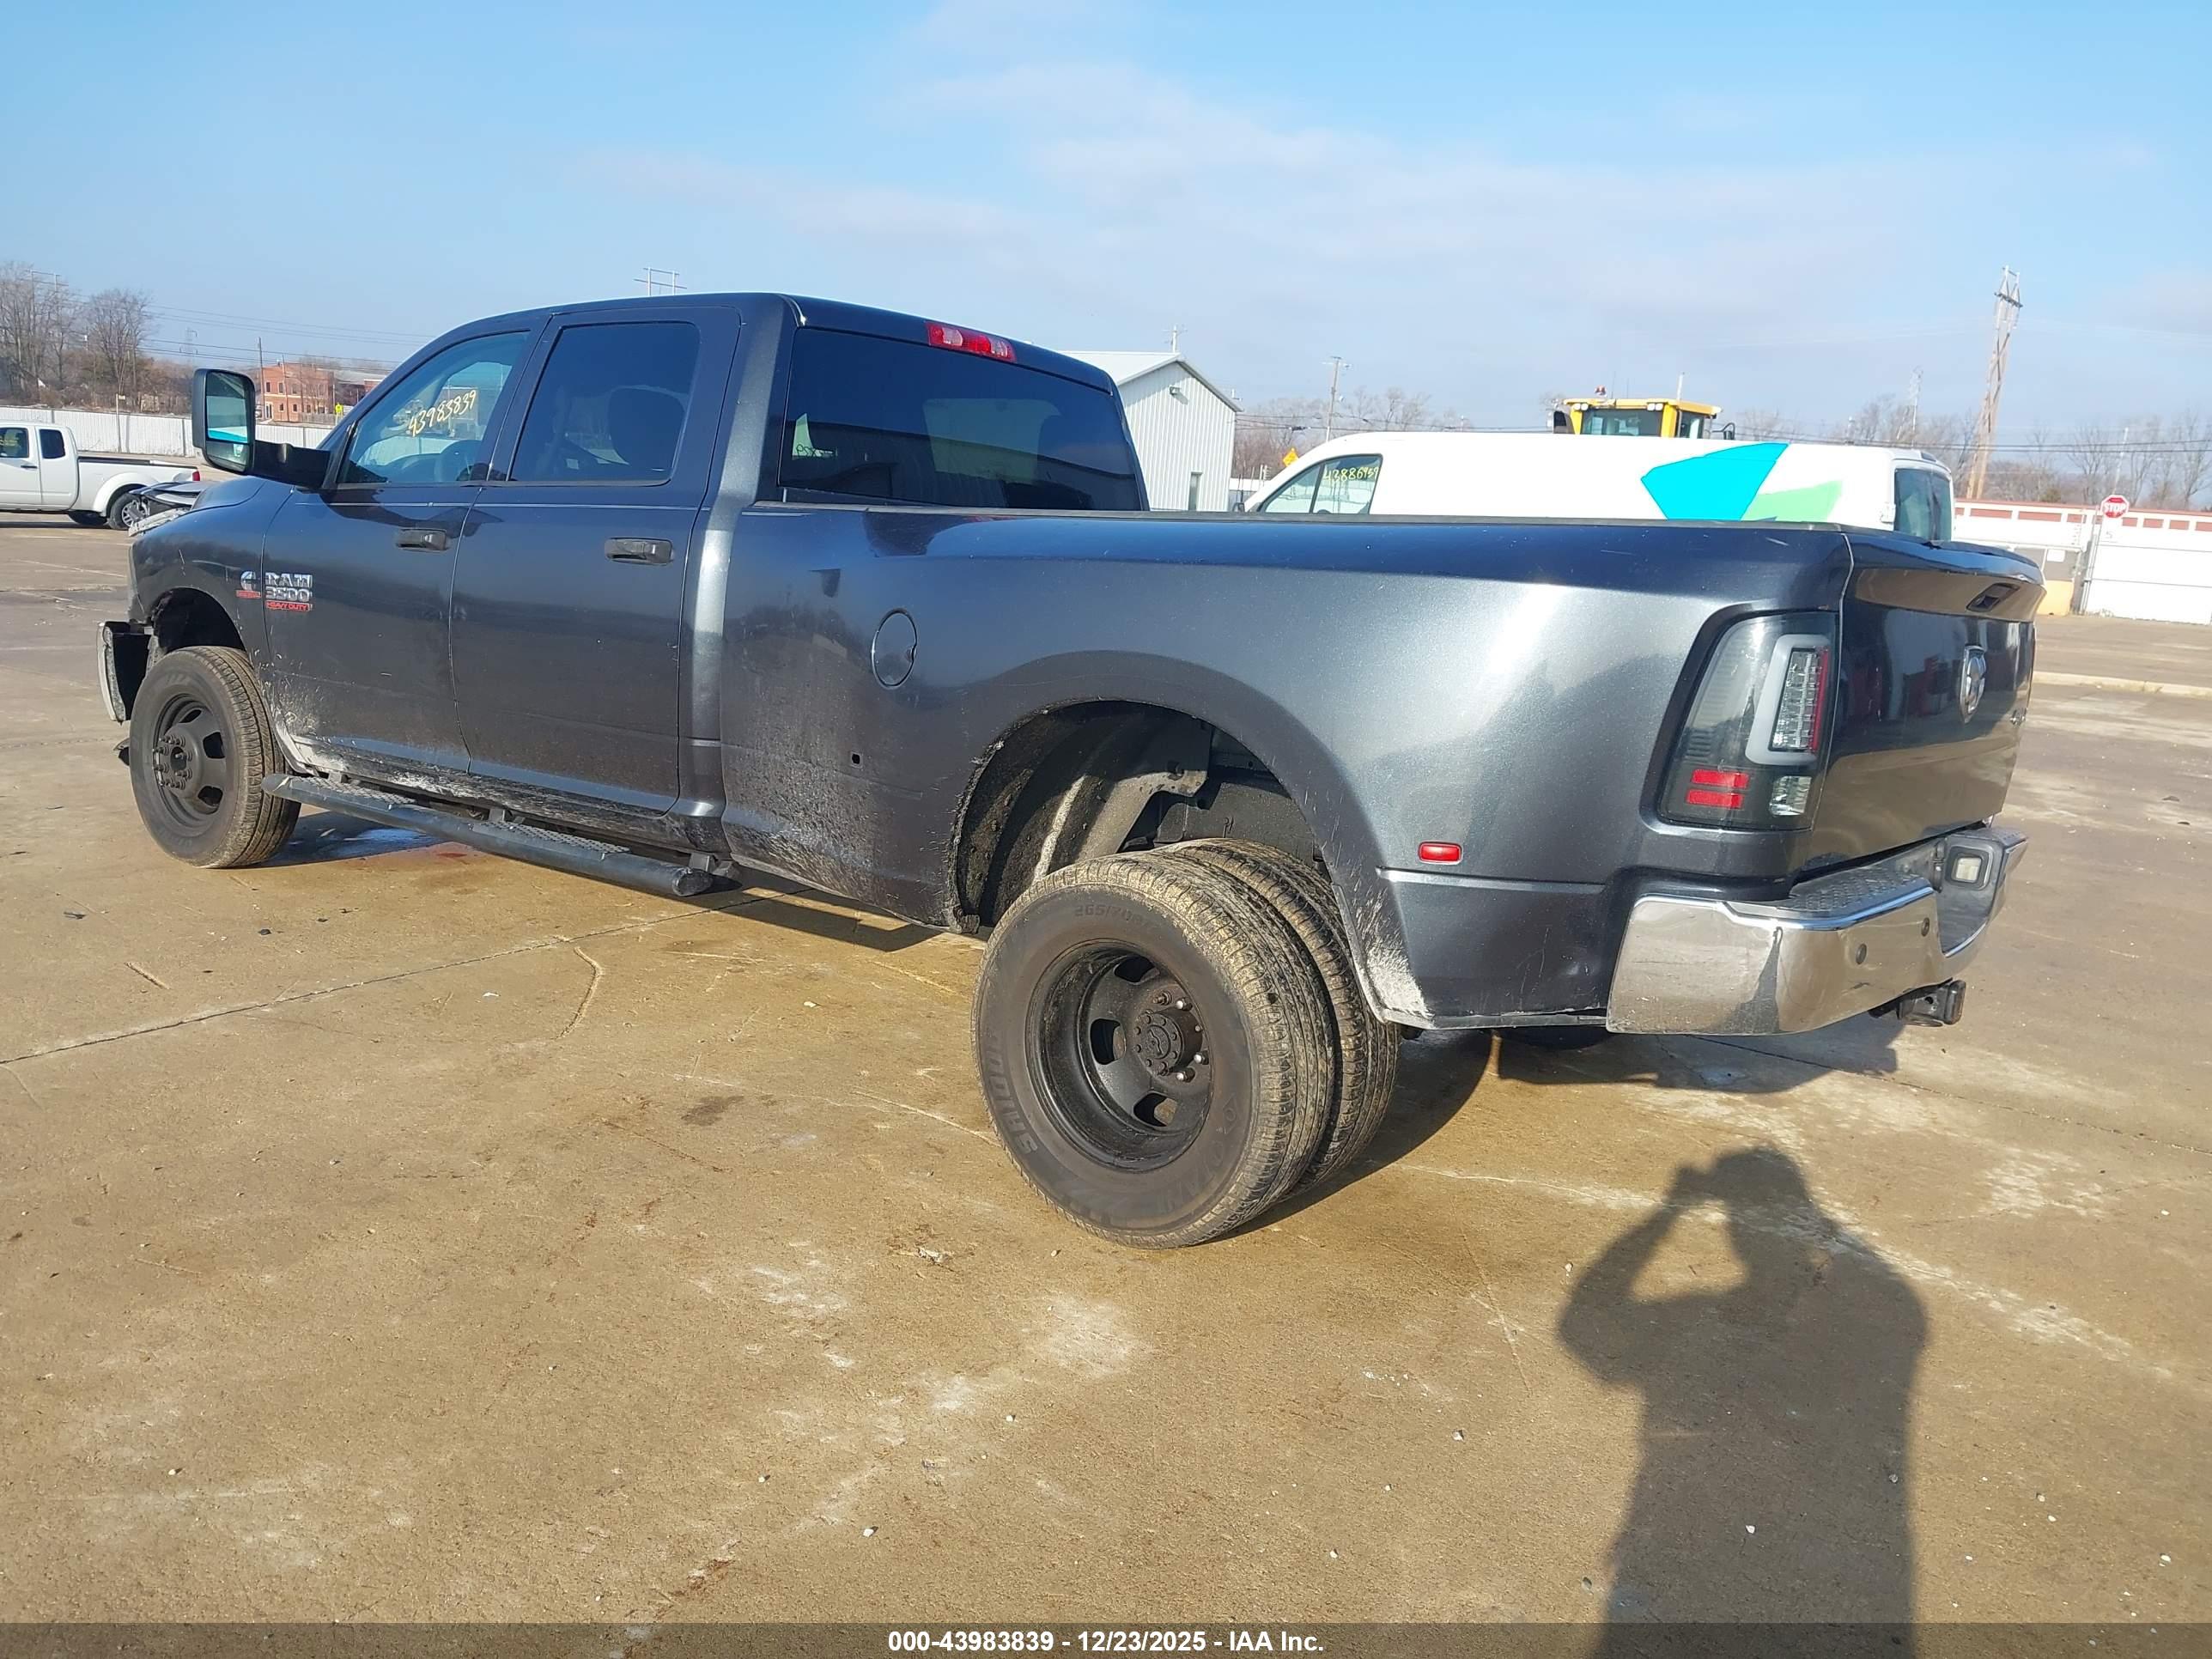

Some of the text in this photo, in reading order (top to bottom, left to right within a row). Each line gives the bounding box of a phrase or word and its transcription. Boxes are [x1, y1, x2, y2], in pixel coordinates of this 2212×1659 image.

[408, 390, 477, 437] 43983839
[2104, 502, 2127, 513] STOP
[264, 572, 313, 588] RAM
[265, 586, 312, 601] 3500
